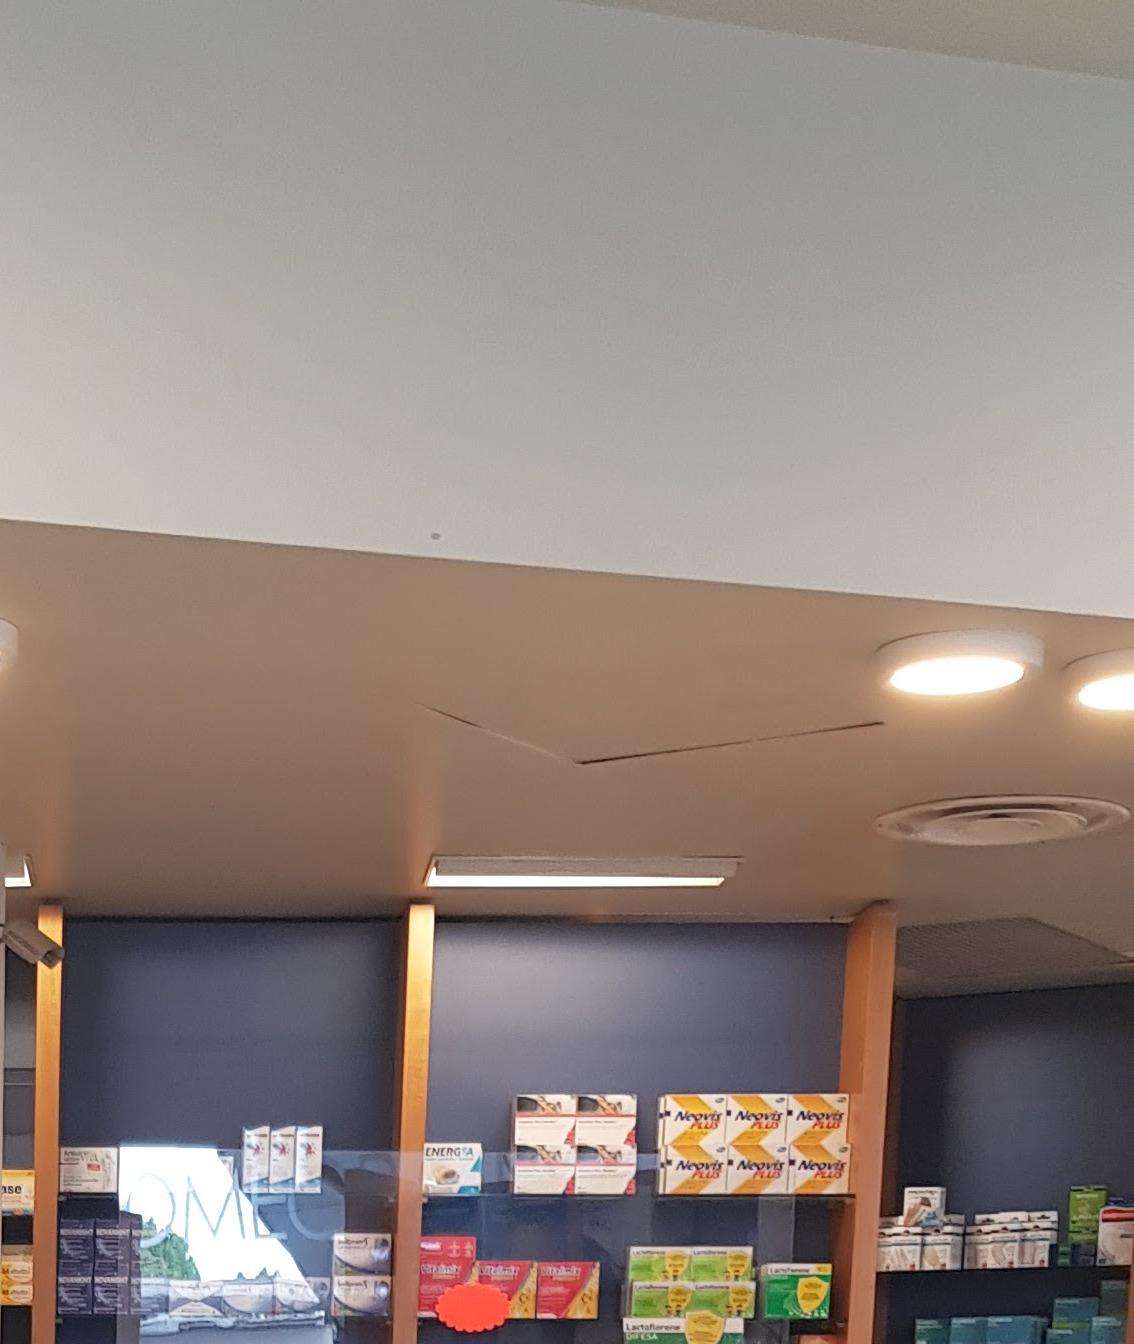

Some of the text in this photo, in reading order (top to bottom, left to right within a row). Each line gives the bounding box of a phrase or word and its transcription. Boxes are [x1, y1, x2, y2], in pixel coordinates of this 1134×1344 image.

[674, 1110, 722, 1122] Neovis
[735, 1110, 782, 1122] Neovis
[796, 1110, 843, 1122] Neovis
